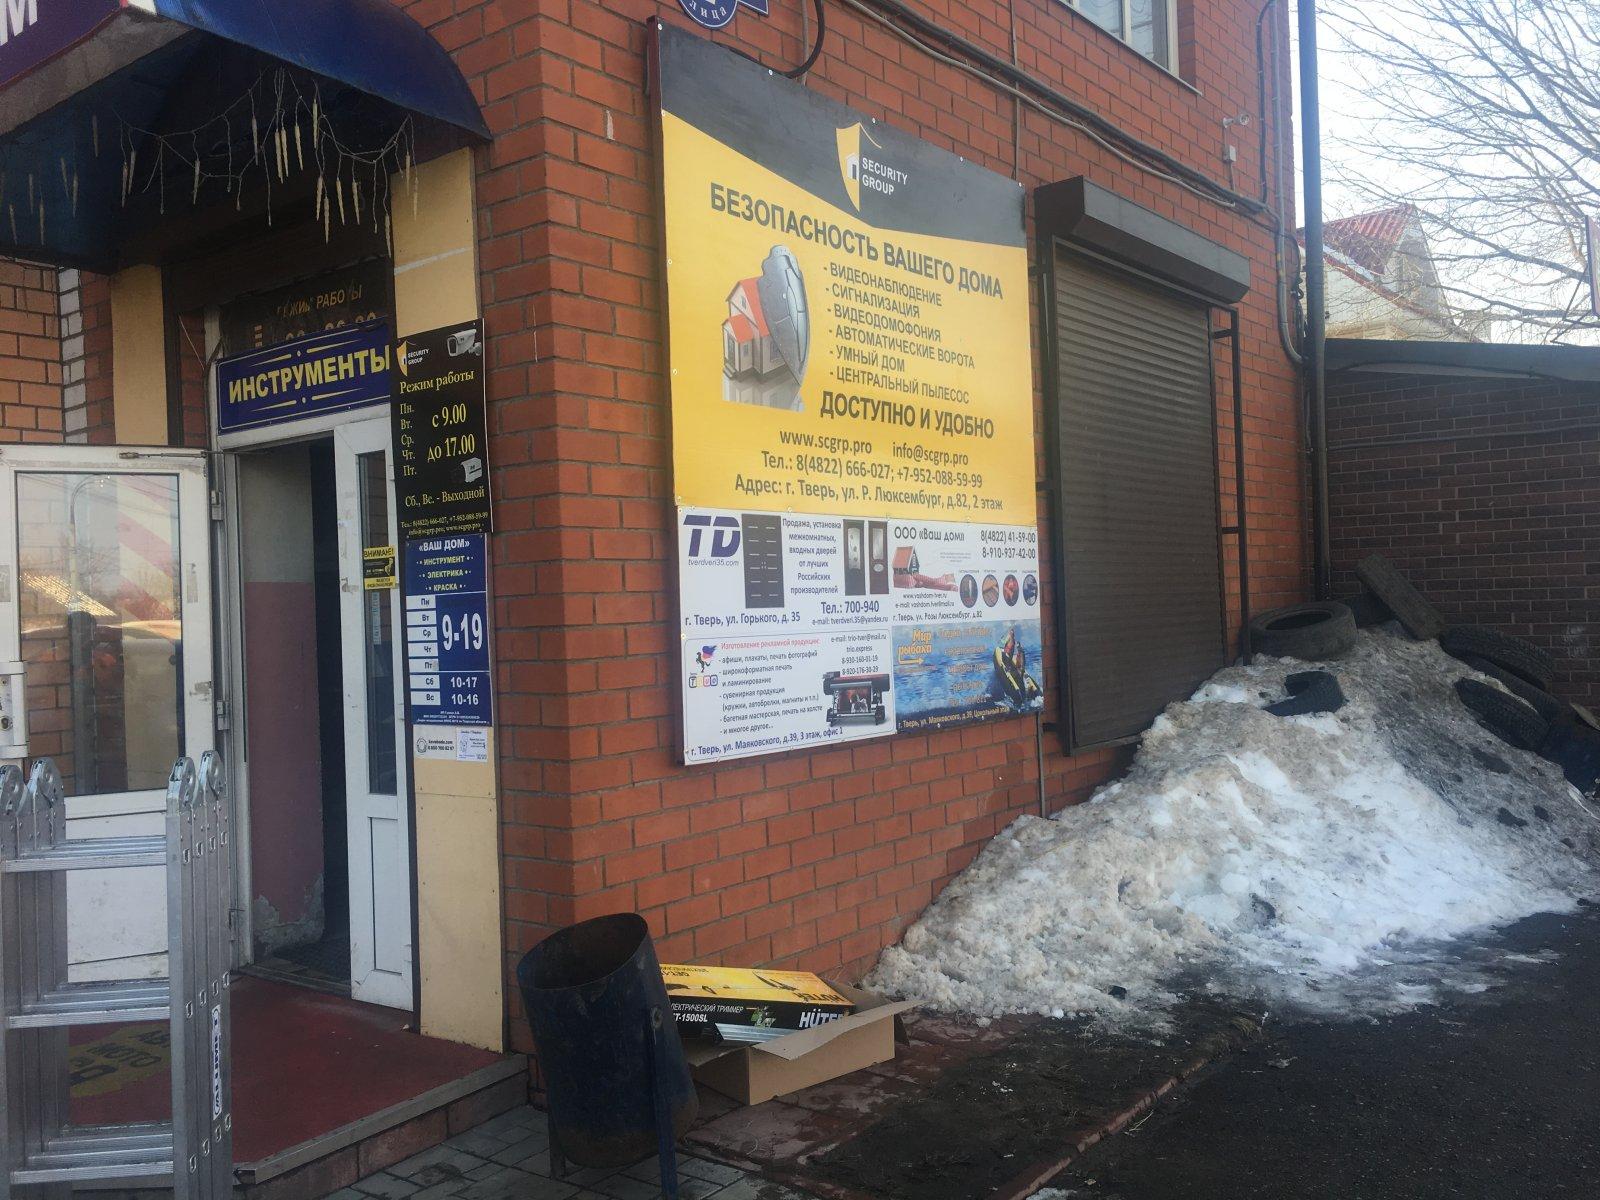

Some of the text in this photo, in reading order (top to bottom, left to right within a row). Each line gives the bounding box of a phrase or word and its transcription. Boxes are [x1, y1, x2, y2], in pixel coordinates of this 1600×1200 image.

[862, 157, 908, 185] SECURITY
[862, 174, 895, 196] GROUP
[710, 182, 1003, 299] БЕЗОПАСНОСТЬ ВАШЕГО ДОМА
[830, 262, 942, 307] ВИДЕОНАБЛЮДЕНИЕ
[832, 283, 920, 319] СИГНАЛИЗАЦИЯ
[834, 303, 941, 342] ВИДЕОДОМОФОНИЯ
[407, 348, 429, 358] SECURITY
[835, 324, 975, 369] АВТОМАТИЧЕСКИЕ ВОРОТА
[407, 357, 423, 365] GROUP
[836, 345, 905, 372] УМНЫЙ ДОМ
[229, 345, 390, 404] ИНСТРУМЕНТЫ
[400, 370, 475, 394] Режим работы
[837, 366, 969, 404] ЦЕНТРАЛЬНЫЙ ПЫЛЕСОС
[400, 403, 415, 414] Пн.
[442, 403, 467, 426] 9.00
[820, 390, 994, 439] ДОСТУПНО И УДОБНО
[401, 419, 413, 430] Вт.
[401, 434, 414, 447] Ср.
[445, 433, 475, 457] 17.00
[402, 450, 416, 460] Чт.
[780, 430, 969, 467] www.scgrp.pro info@scgrp.pro
[403, 465, 417, 476] Пт.
[761, 450, 982, 488] Тел.: 8(4822) 666-027; +7-952-088-59-99
[441, 486, 485, 502] Выходной
[735, 473, 1003, 511] Адрес: г. Тверь, ул. Р. Люксембург, д.82, 2 этаж
[782, 518, 841, 529] Продажа, установка
[894, 526, 917, 540] ООО
[919, 529, 942, 541] «Ваш
[981, 530, 1036, 544] 8(4822) 41-59-00
[419, 539, 470, 552] «ВАШ ДОМ»
[789, 547, 837, 555] входных дверей
[423, 555, 465, 565] ИНСТРУМЕНТ
[982, 547, 1036, 560] 8-910-937-42-00
[806, 561, 829, 569] лучших
[427, 570, 464, 579] ЭЛЕКТРИКА
[798, 572, 831, 581] Российских
[433, 583, 458, 591] КРАСКА
[790, 585, 839, 596] производителей
[420, 598, 430, 606] Пн
[821, 600, 879, 614] Тел.: 700-940
[685, 611, 800, 628] г. Тверь, ул. Горького, д. 35
[422, 630, 431, 638] Ср
[442, 613, 483, 650] 9-19
[912, 628, 932, 643] Мир
[721, 642, 760, 650] Изготовление
[760, 639, 790, 649] рекламной
[788, 650, 818, 659] фотографий
[722, 666, 774, 676] широкоформатная
[451, 676, 478, 688] 10-17
[727, 677, 772, 687] ламинирование
[756, 687, 785, 696] продукция
[451, 694, 479, 705] 10-16
[781, 708, 799, 716] печать
[698, 746, 721, 756] Тверь,
[723, 744, 733, 753] ул.
[735, 738, 782, 750] Маяковского,
[805, 732, 821, 741] этаж,
[823, 730, 837, 738] офис
[670, 1002, 744, 1013] ЛЕКТРИЧЕСКИЙ ТРИММЕР
[673, 1012, 708, 1022] T-1500SL
[799, 1008, 848, 1028] HÜTE
